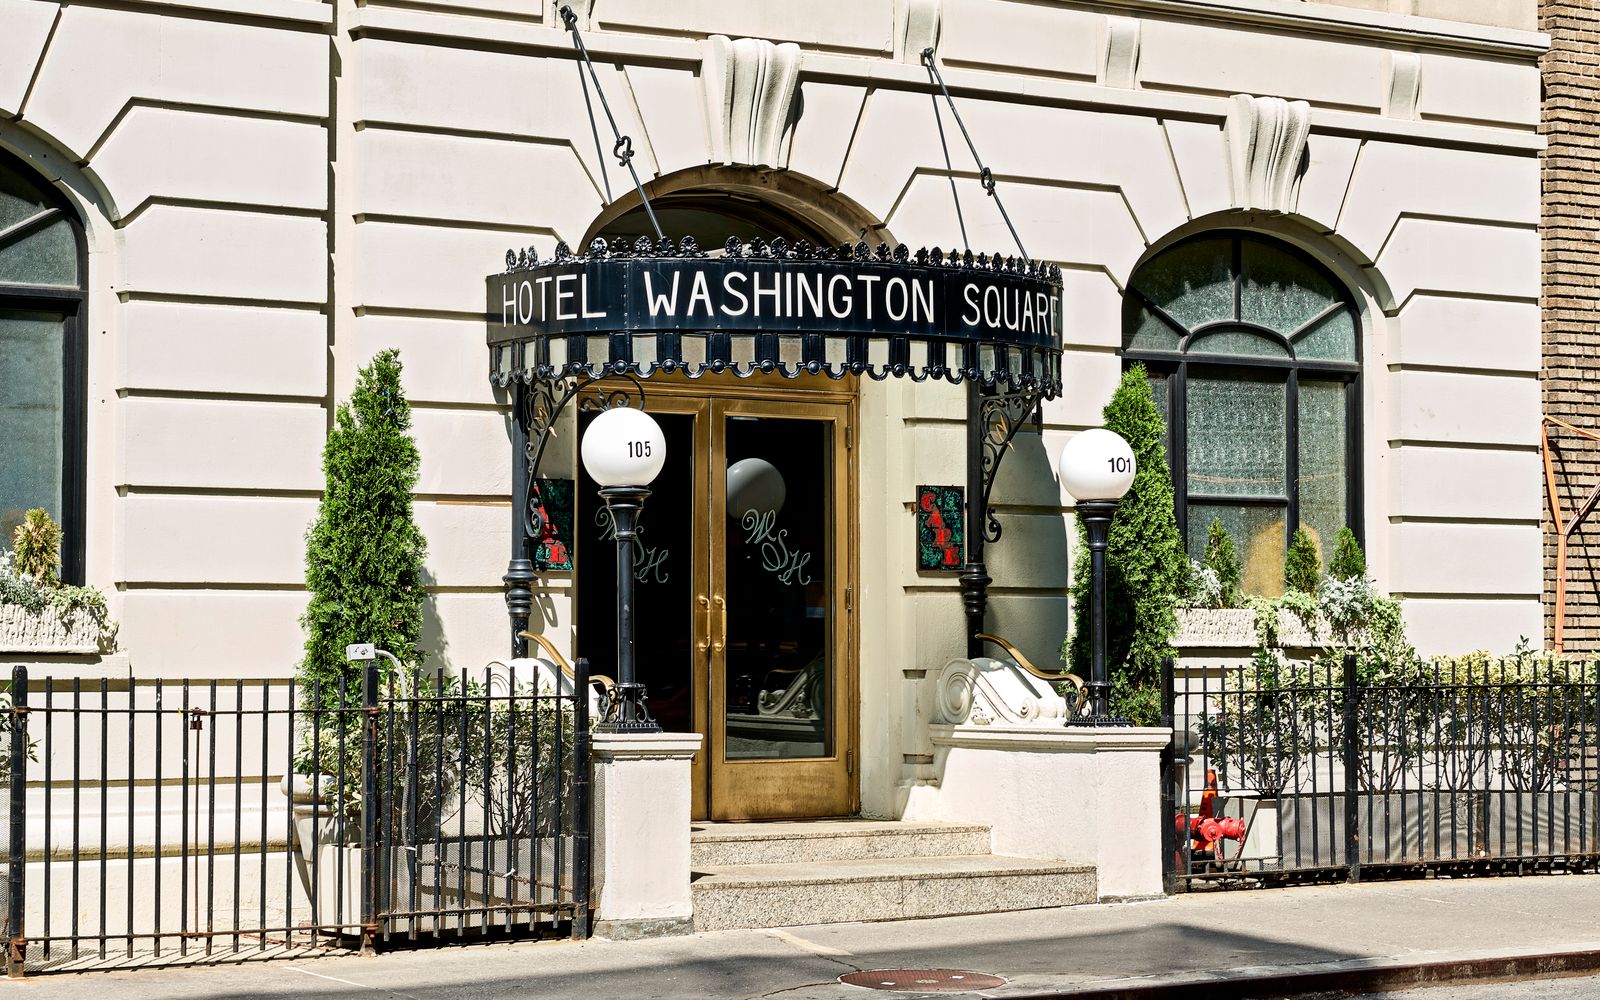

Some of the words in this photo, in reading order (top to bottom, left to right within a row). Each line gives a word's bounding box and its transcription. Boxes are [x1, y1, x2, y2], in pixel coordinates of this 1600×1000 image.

[503, 273, 607, 328] HOTEL
[643, 270, 935, 323] WASHINGTON
[627, 441, 652, 458] 105
[1107, 456, 1131, 473] 101
[921, 492, 960, 566] CAFE
